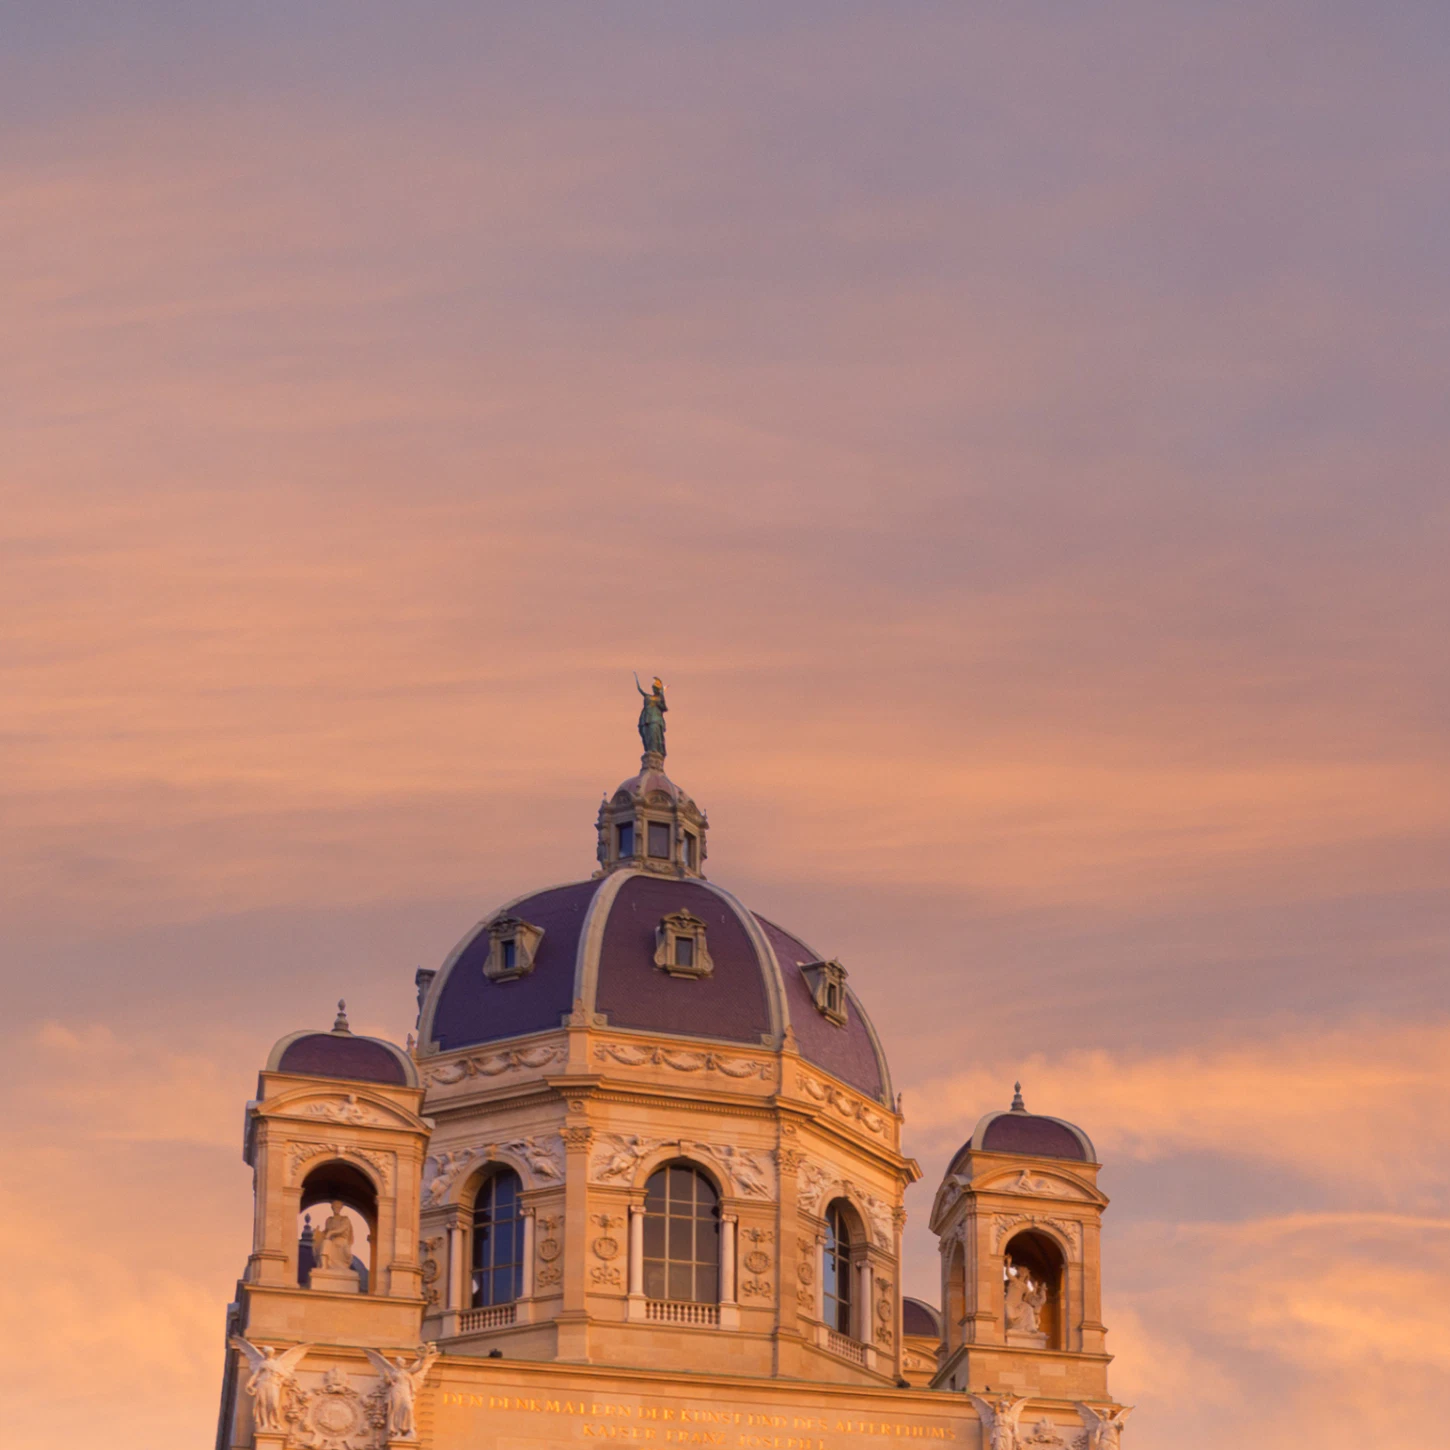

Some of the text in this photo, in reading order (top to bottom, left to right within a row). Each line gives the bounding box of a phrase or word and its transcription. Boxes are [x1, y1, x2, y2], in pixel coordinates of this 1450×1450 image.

[444, 1392, 483, 1407] DEN
[638, 1406, 675, 1421] DER
[680, 1409, 742, 1425] KUNST
[747, 1413, 787, 1428] UND
[794, 1415, 828, 1431] DES
[583, 1423, 656, 1440] KAISER
[666, 1429, 726, 1445] FRANZ
[739, 1433, 811, 1450] JOSEPH
